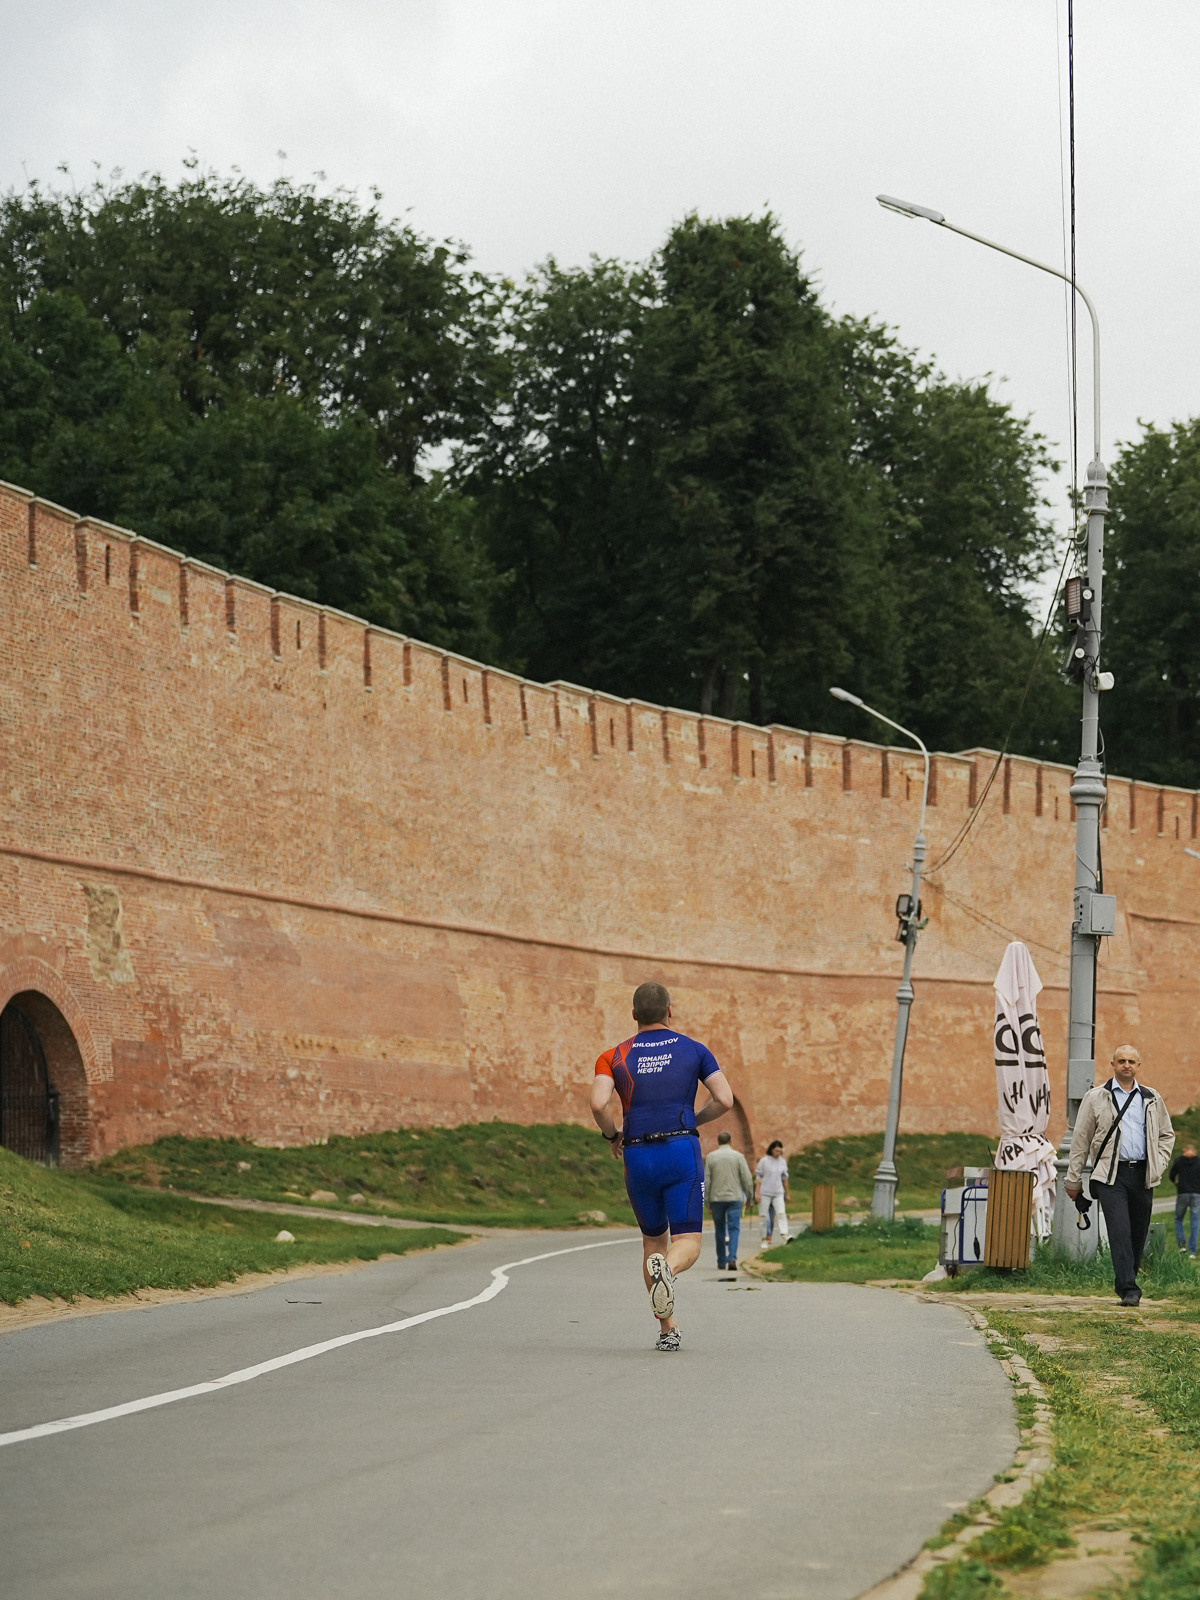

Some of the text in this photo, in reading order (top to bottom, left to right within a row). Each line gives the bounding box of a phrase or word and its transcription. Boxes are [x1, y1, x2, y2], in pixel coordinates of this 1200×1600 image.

[632, 1037, 679, 1048] KHLOBYSTOV
[638, 1053, 672, 1062] КОМАНДА
[637, 1059, 670, 1068] ГАЗПРОМ
